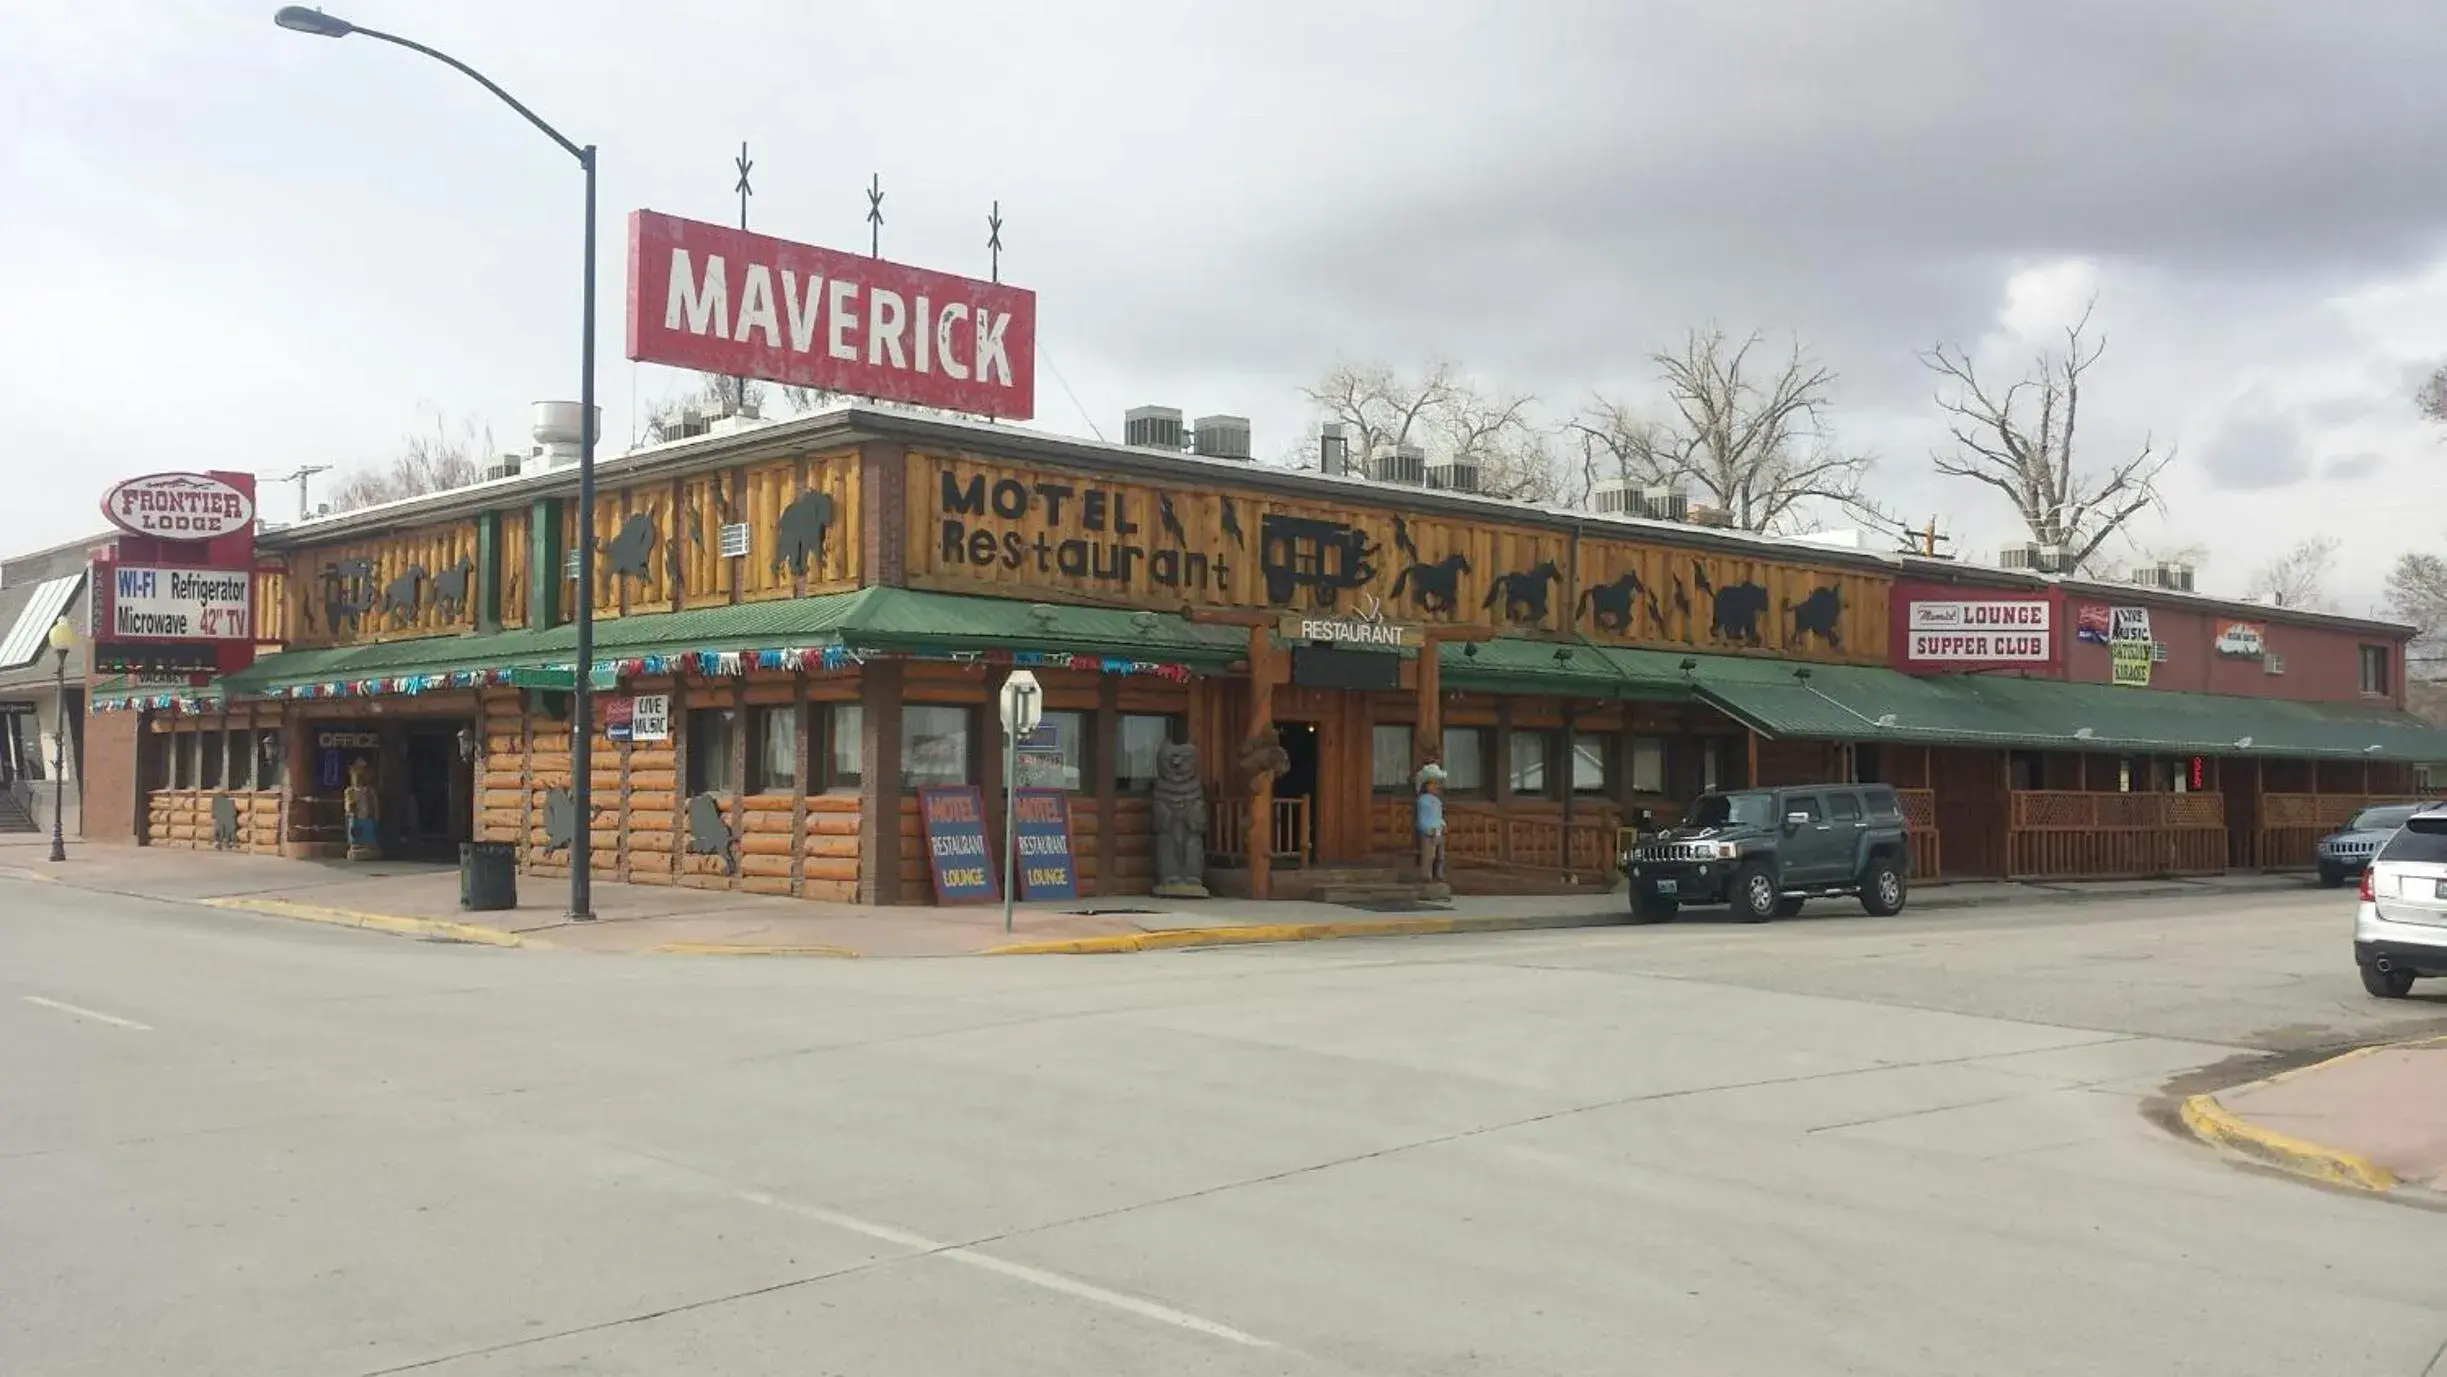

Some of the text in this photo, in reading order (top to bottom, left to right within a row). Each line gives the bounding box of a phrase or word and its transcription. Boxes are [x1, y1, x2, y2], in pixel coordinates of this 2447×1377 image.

[664, 247, 1014, 388] MAVERICK
[122, 489, 242, 518] FRONTIER
[941, 471, 1138, 534] MOTEL
[142, 515, 221, 531] LODGE
[942, 519, 1229, 590] Restaurant
[118, 570, 246, 607] WI-FI Refrigerator
[118, 606, 246, 636] Microwave 42" TV
[1963, 606, 2042, 624] LOUNGE
[1301, 620, 1404, 645] RESTAURANT
[1917, 637, 2042, 655] SUPPER CLUB
[638, 697, 662, 715] LIVE
[634, 717, 666, 734] MUSIC
[319, 732, 380, 748] OFFICE
[927, 795, 979, 823] MOTEL
[931, 834, 985, 856] RESTAURANT
[1018, 835, 1068, 856] RESTAURANT
[942, 867, 987, 888] LOUNGE
[1027, 867, 1069, 886] LOUNGE
